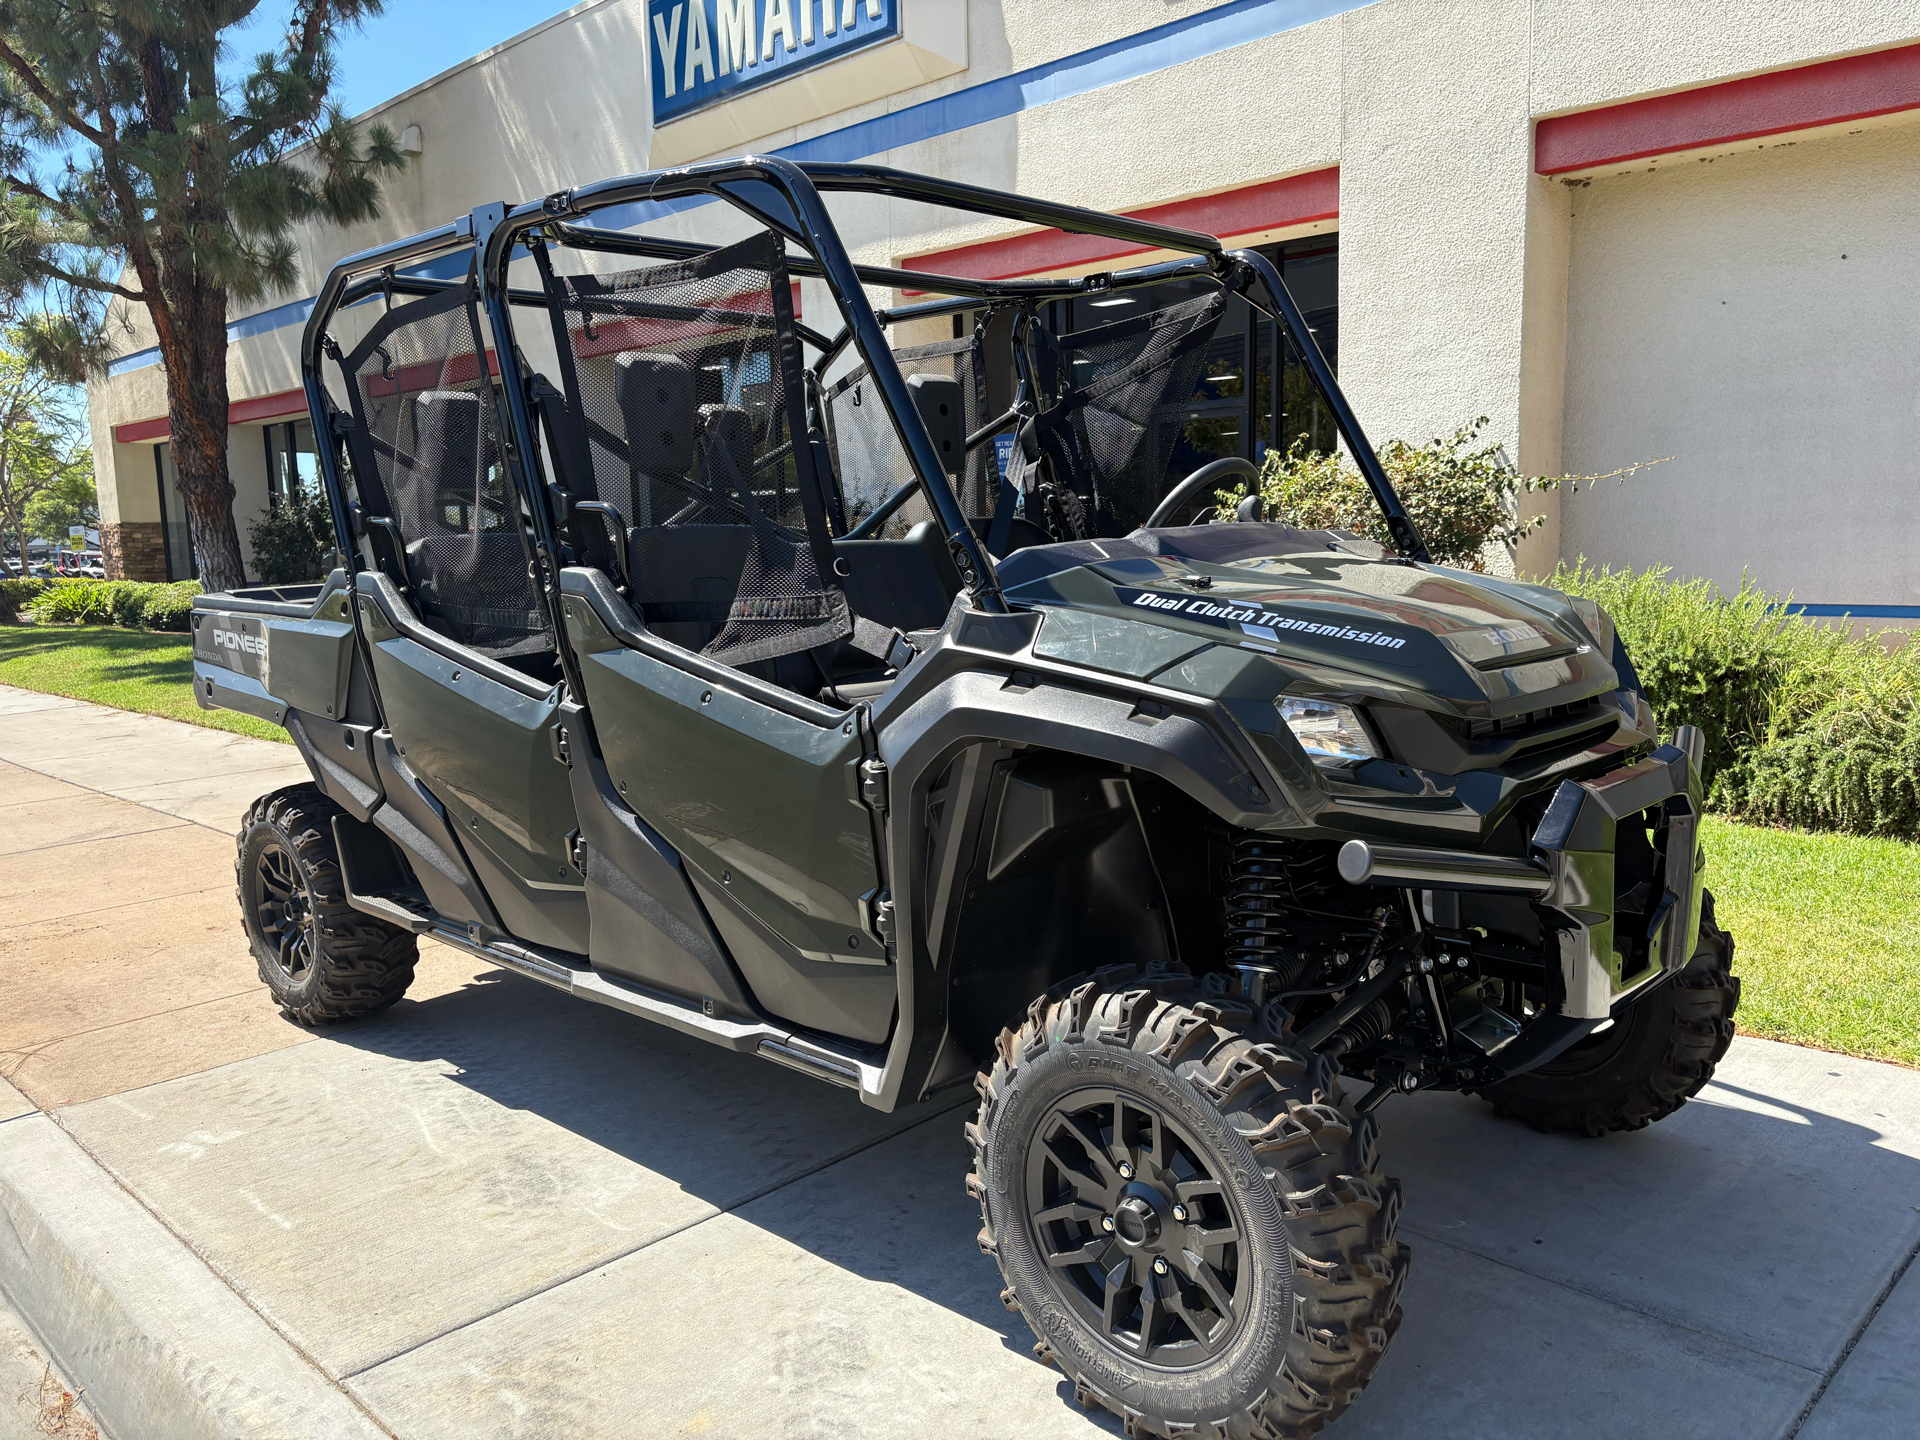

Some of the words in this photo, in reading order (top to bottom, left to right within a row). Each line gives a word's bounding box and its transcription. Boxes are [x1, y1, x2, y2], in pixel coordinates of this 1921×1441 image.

[998, 448, 1012, 460] RI
[1133, 592, 1188, 611] Dual
[1185, 600, 1256, 622] Clutch
[1258, 611, 1407, 650] Transmission
[1482, 624, 1551, 646] HONDA
[197, 649, 223, 662] HONDA
